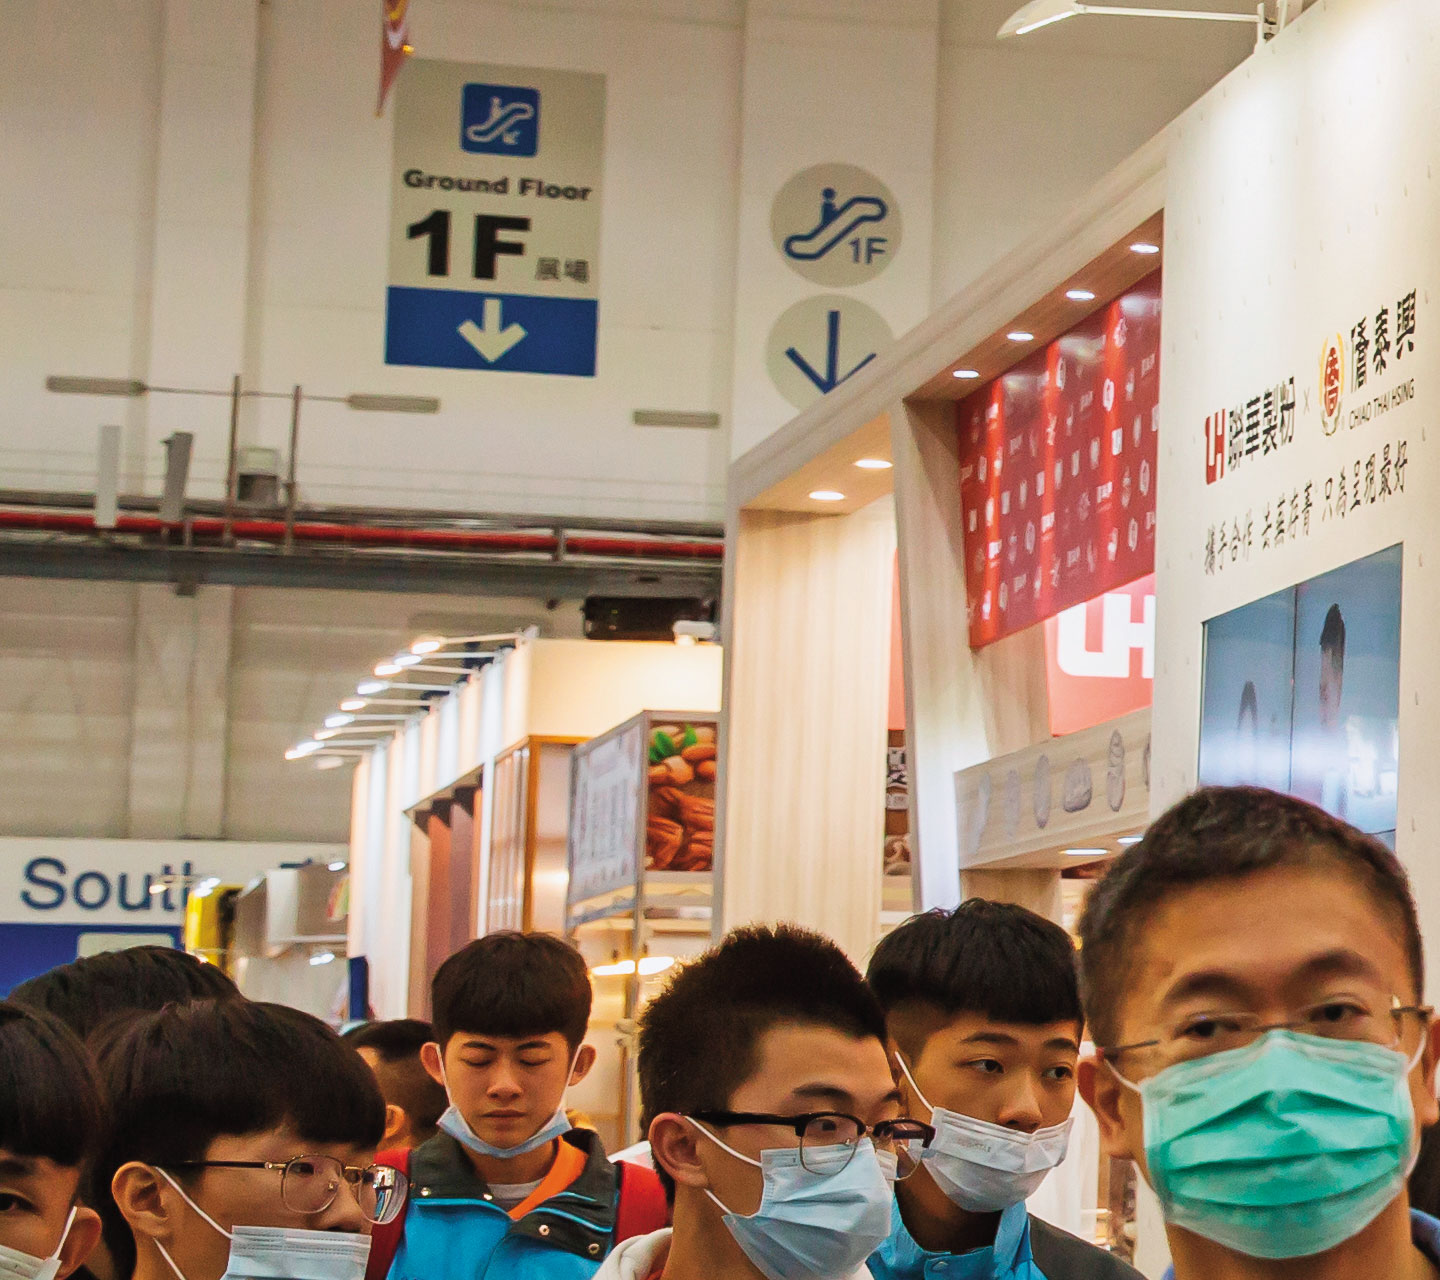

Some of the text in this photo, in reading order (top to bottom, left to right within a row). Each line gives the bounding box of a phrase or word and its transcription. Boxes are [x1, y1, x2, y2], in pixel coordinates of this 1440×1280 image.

[403, 169, 592, 202] Ground Floor
[406, 208, 590, 286] 1F 展場
[848, 236, 888, 266] 1F
[1227, 376, 1296, 472] 聯華製粉
